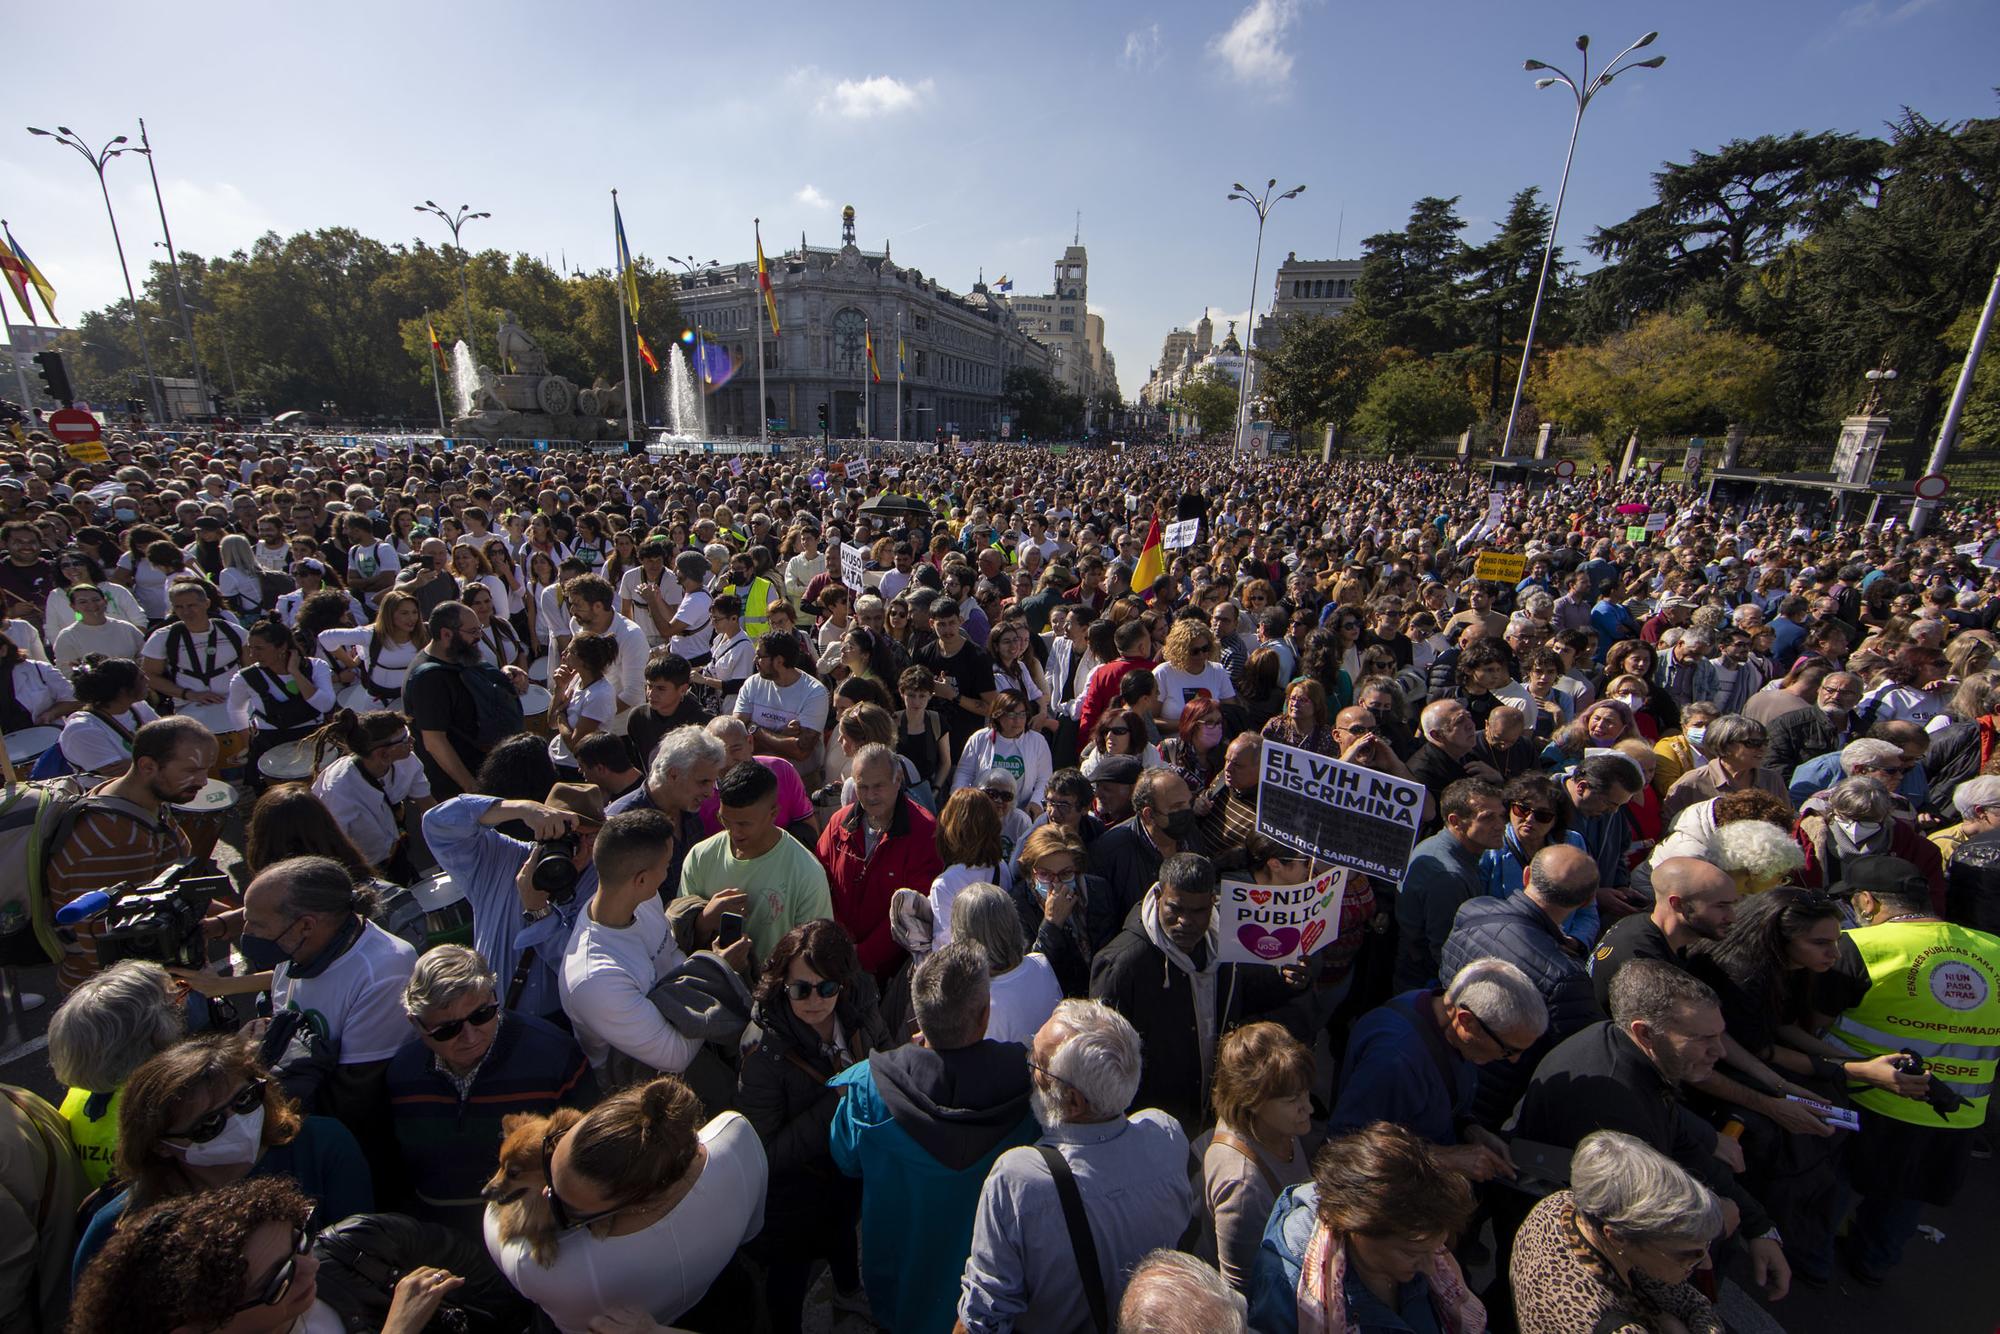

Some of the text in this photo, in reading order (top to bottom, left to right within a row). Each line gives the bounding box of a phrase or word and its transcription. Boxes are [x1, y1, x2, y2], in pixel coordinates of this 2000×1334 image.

[842, 550, 862, 569] AYUSO
[1265, 767, 1415, 827] DISCRIMINA
[1267, 748, 1418, 808] EL VIH NO
[1262, 822, 1402, 878] TU POLÍTICA SANITARIA SÍ
[1907, 944, 1994, 997] PENSIONES PÚBLICAS PARA
[1945, 973, 1970, 982] NI UN
[1946, 982, 1972, 991] PASO
